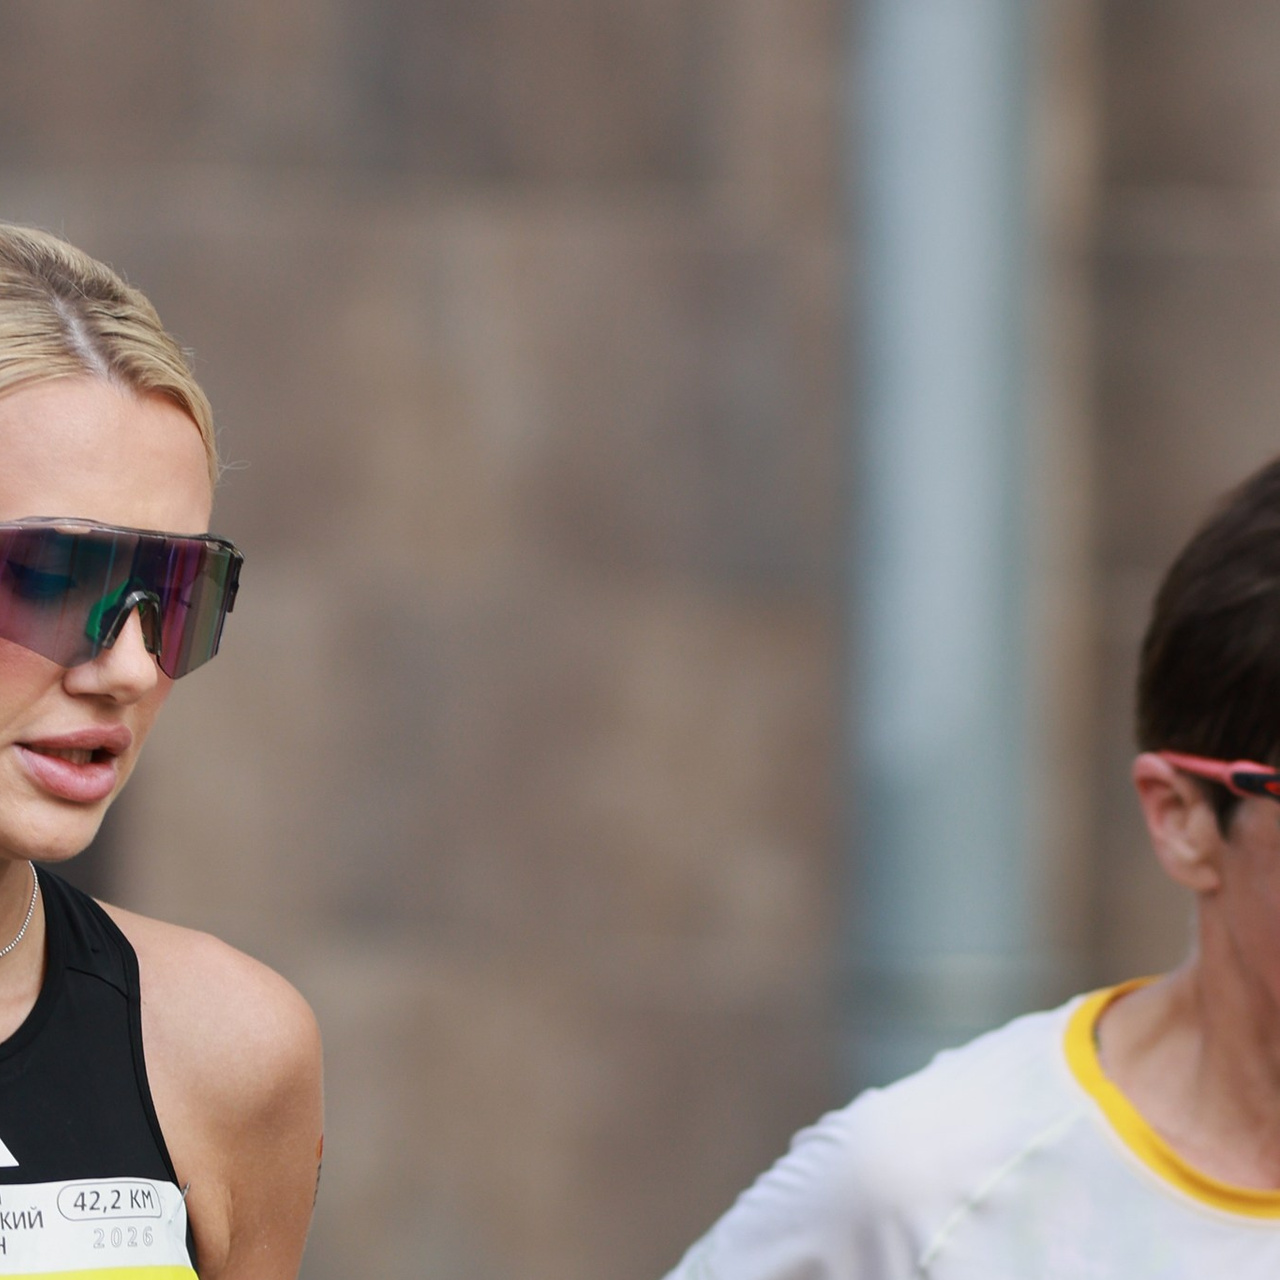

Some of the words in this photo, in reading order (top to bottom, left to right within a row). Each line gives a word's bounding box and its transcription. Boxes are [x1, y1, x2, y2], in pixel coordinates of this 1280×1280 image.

[73, 1190, 121, 1213] 42,2
[130, 1188, 155, 1210] КМ
[93, 1226, 154, 1249] 2026
